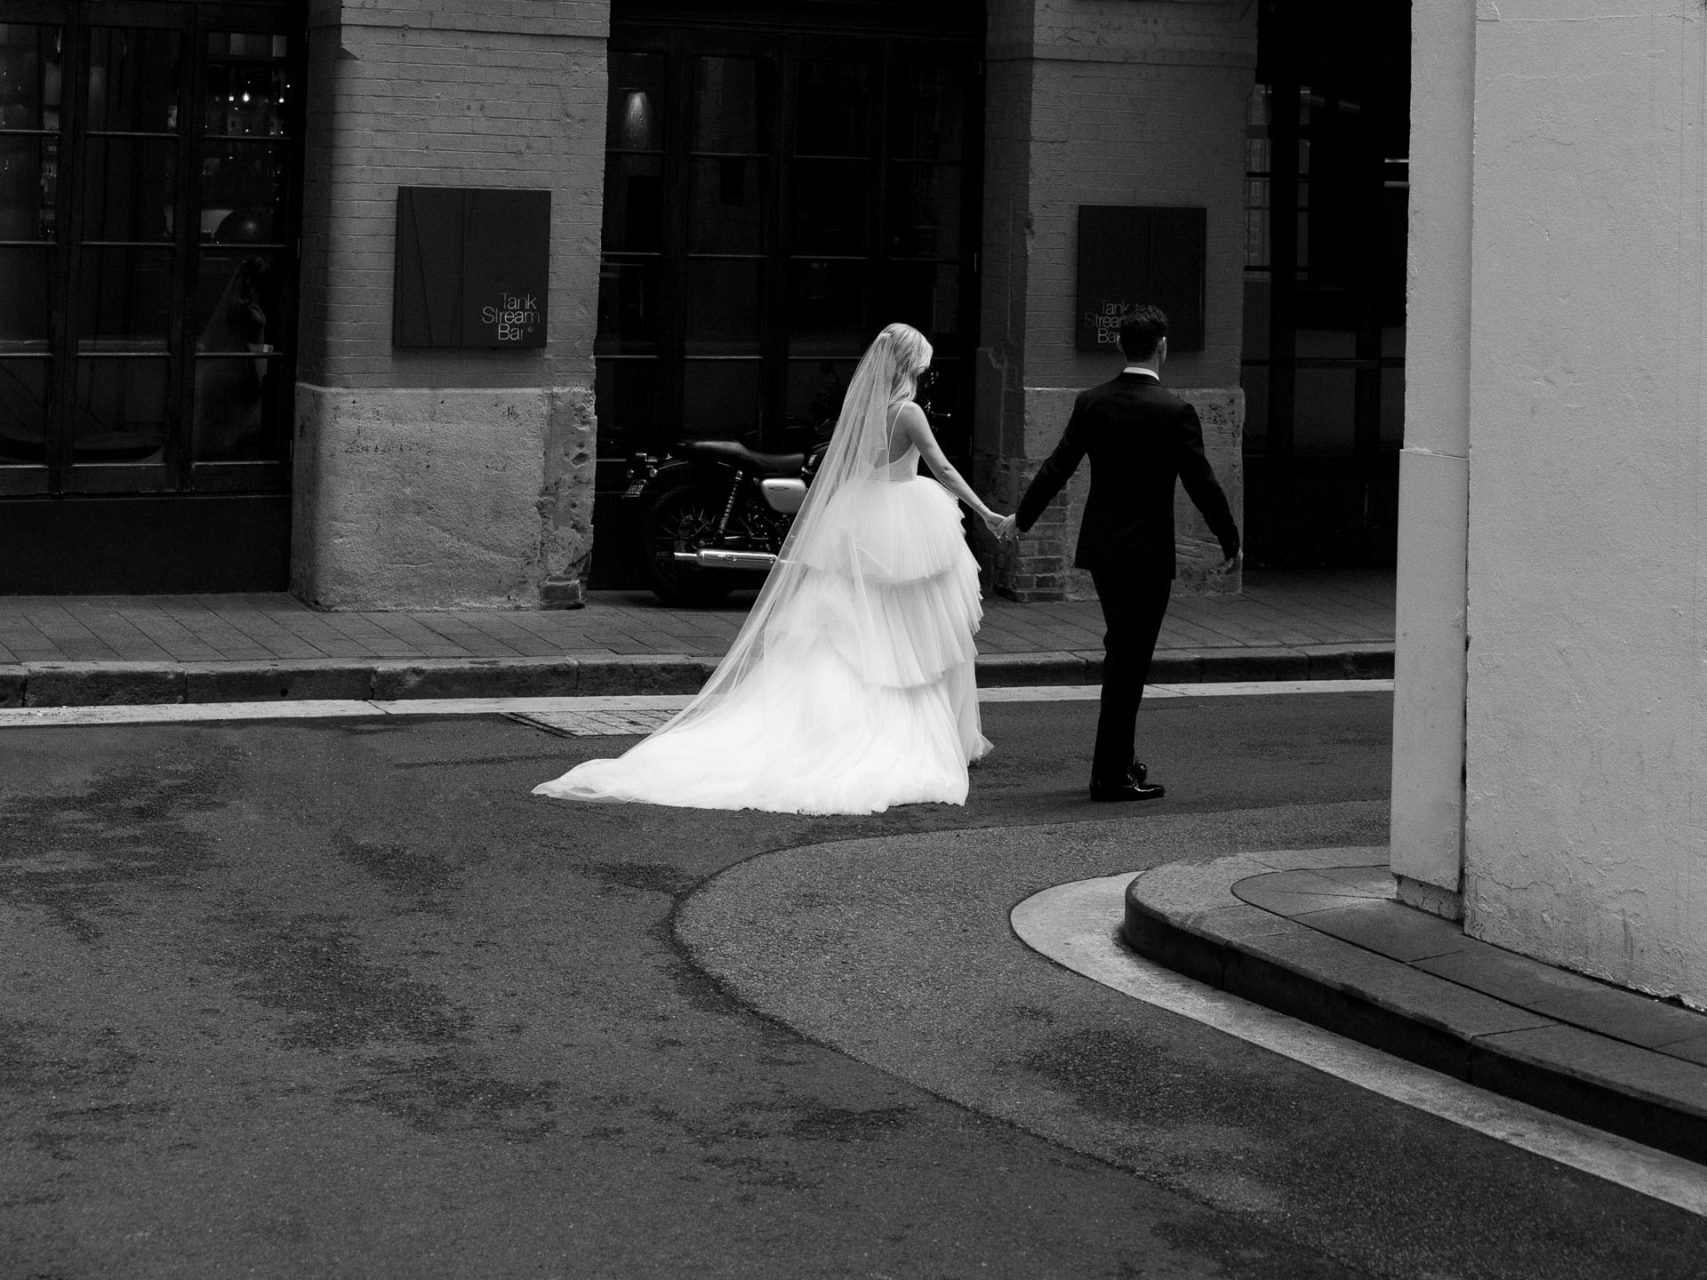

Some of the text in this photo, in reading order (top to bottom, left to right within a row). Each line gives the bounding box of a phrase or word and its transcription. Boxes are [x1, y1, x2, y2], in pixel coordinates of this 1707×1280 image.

[498, 292, 537, 310] Tank
[1099, 299, 1131, 315] Tank
[481, 305, 540, 324] Stream
[1084, 312, 1123, 329] Strea
[498, 323, 523, 341] Bar
